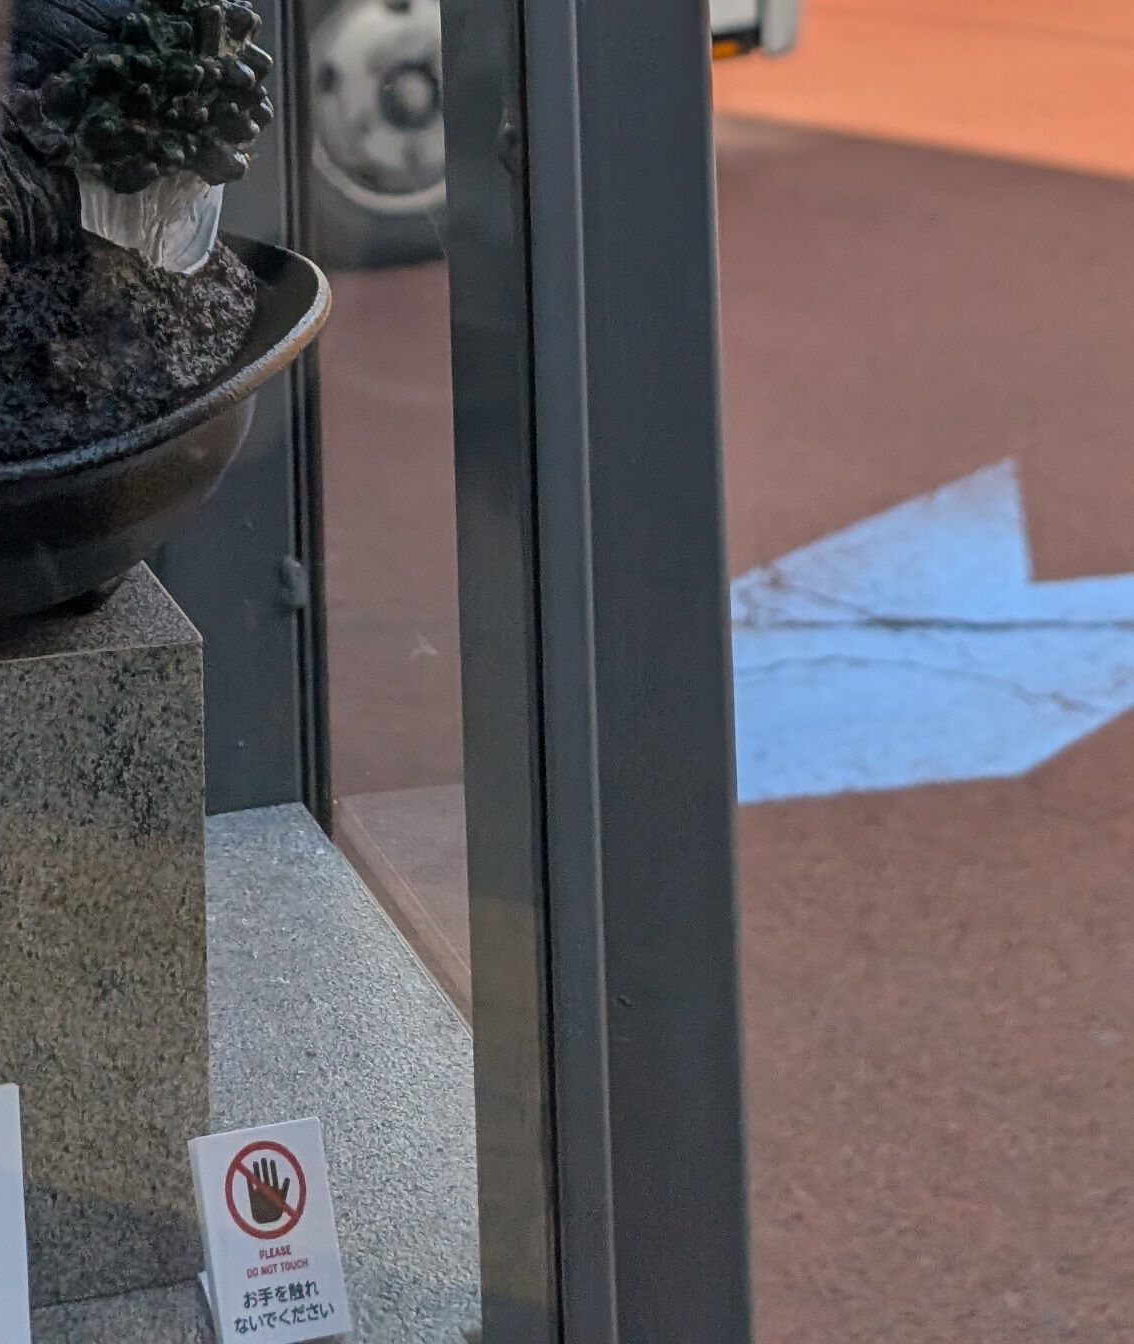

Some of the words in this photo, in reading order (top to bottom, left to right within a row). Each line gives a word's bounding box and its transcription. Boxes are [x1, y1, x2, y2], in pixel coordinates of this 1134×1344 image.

[259, 1244, 292, 1260] PLEASE
[247, 1267, 259, 1279] DO
[260, 1262, 278, 1276] NOT
[280, 1257, 309, 1272] TOUCH
[243, 1279, 320, 1309] お手を触れ
[233, 1302, 335, 1334] ないでください
